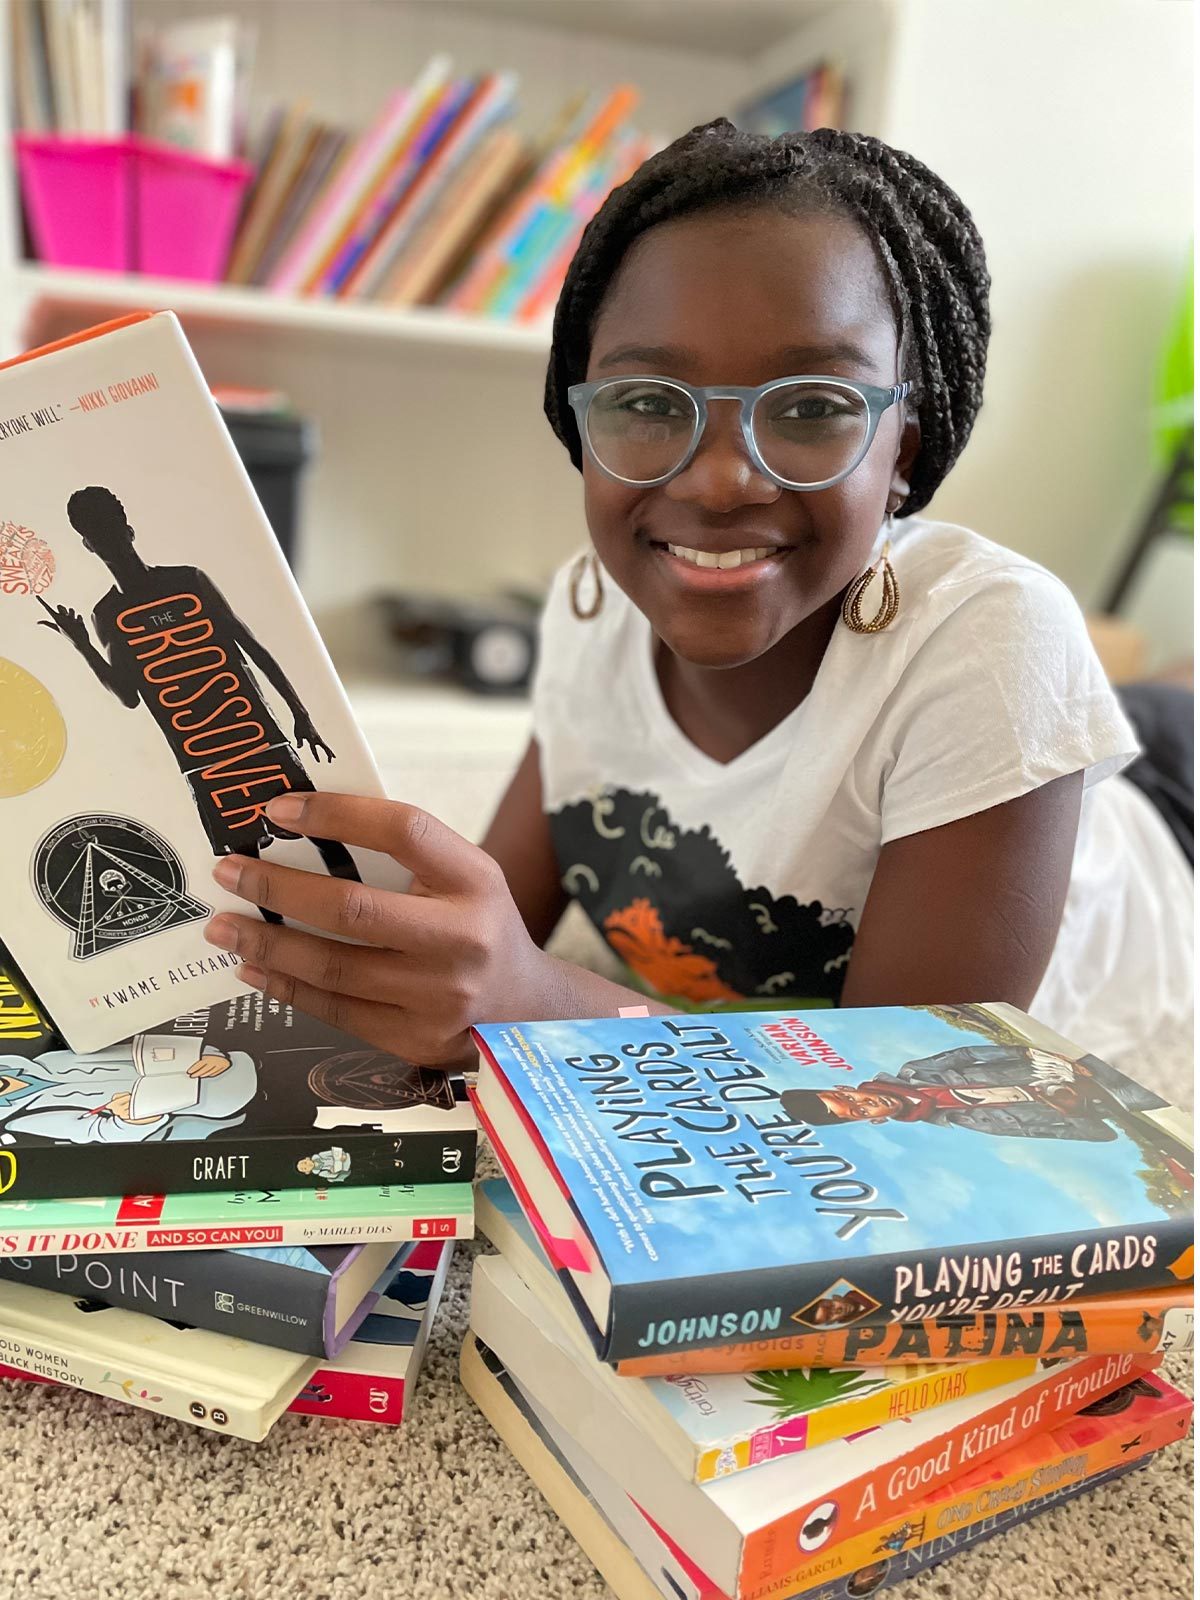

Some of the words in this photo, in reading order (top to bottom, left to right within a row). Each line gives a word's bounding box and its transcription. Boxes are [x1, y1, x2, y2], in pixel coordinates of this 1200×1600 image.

[107, 372, 160, 403] GIOVANNI
[149, 610, 177, 627] THE
[122, 912, 150, 927] HONOR
[103, 976, 161, 1009] KWAME
[661, 1018, 787, 1105] DEALT
[760, 1024, 819, 1066] VARIAN
[778, 1017, 854, 1071] JOHNSON
[621, 1041, 742, 1135] CARDS
[193, 1155, 250, 1181] CRAFT
[704, 1141, 792, 1205] THE
[27, 1234, 56, 1252] IT
[61, 1231, 140, 1250] DONE
[151, 1231, 182, 1244] AND
[186, 1230, 206, 1243] SO
[210, 1229, 241, 1242] CAN
[242, 1227, 280, 1242] YOU!
[1032, 1254, 1063, 1278] THE
[1070, 1234, 1158, 1278] CARDS
[55, 1253, 185, 1307] POINT
[236, 1301, 308, 1327] GREENWILLOW
[638, 1306, 783, 1348] JOHNSON
[842, 1309, 1091, 1362] PATINA
[25, 1348, 69, 1368] WOMEN
[34, 1362, 86, 1387] HISTORY
[888, 1386, 930, 1420] HELLO
[932, 1370, 969, 1404] STARS
[854, 1482, 878, 1522] A
[887, 1440, 952, 1501] Good
[959, 1406, 1016, 1465] Kind
[1021, 1391, 1050, 1429] of
[1054, 1353, 1134, 1412] Trouble
